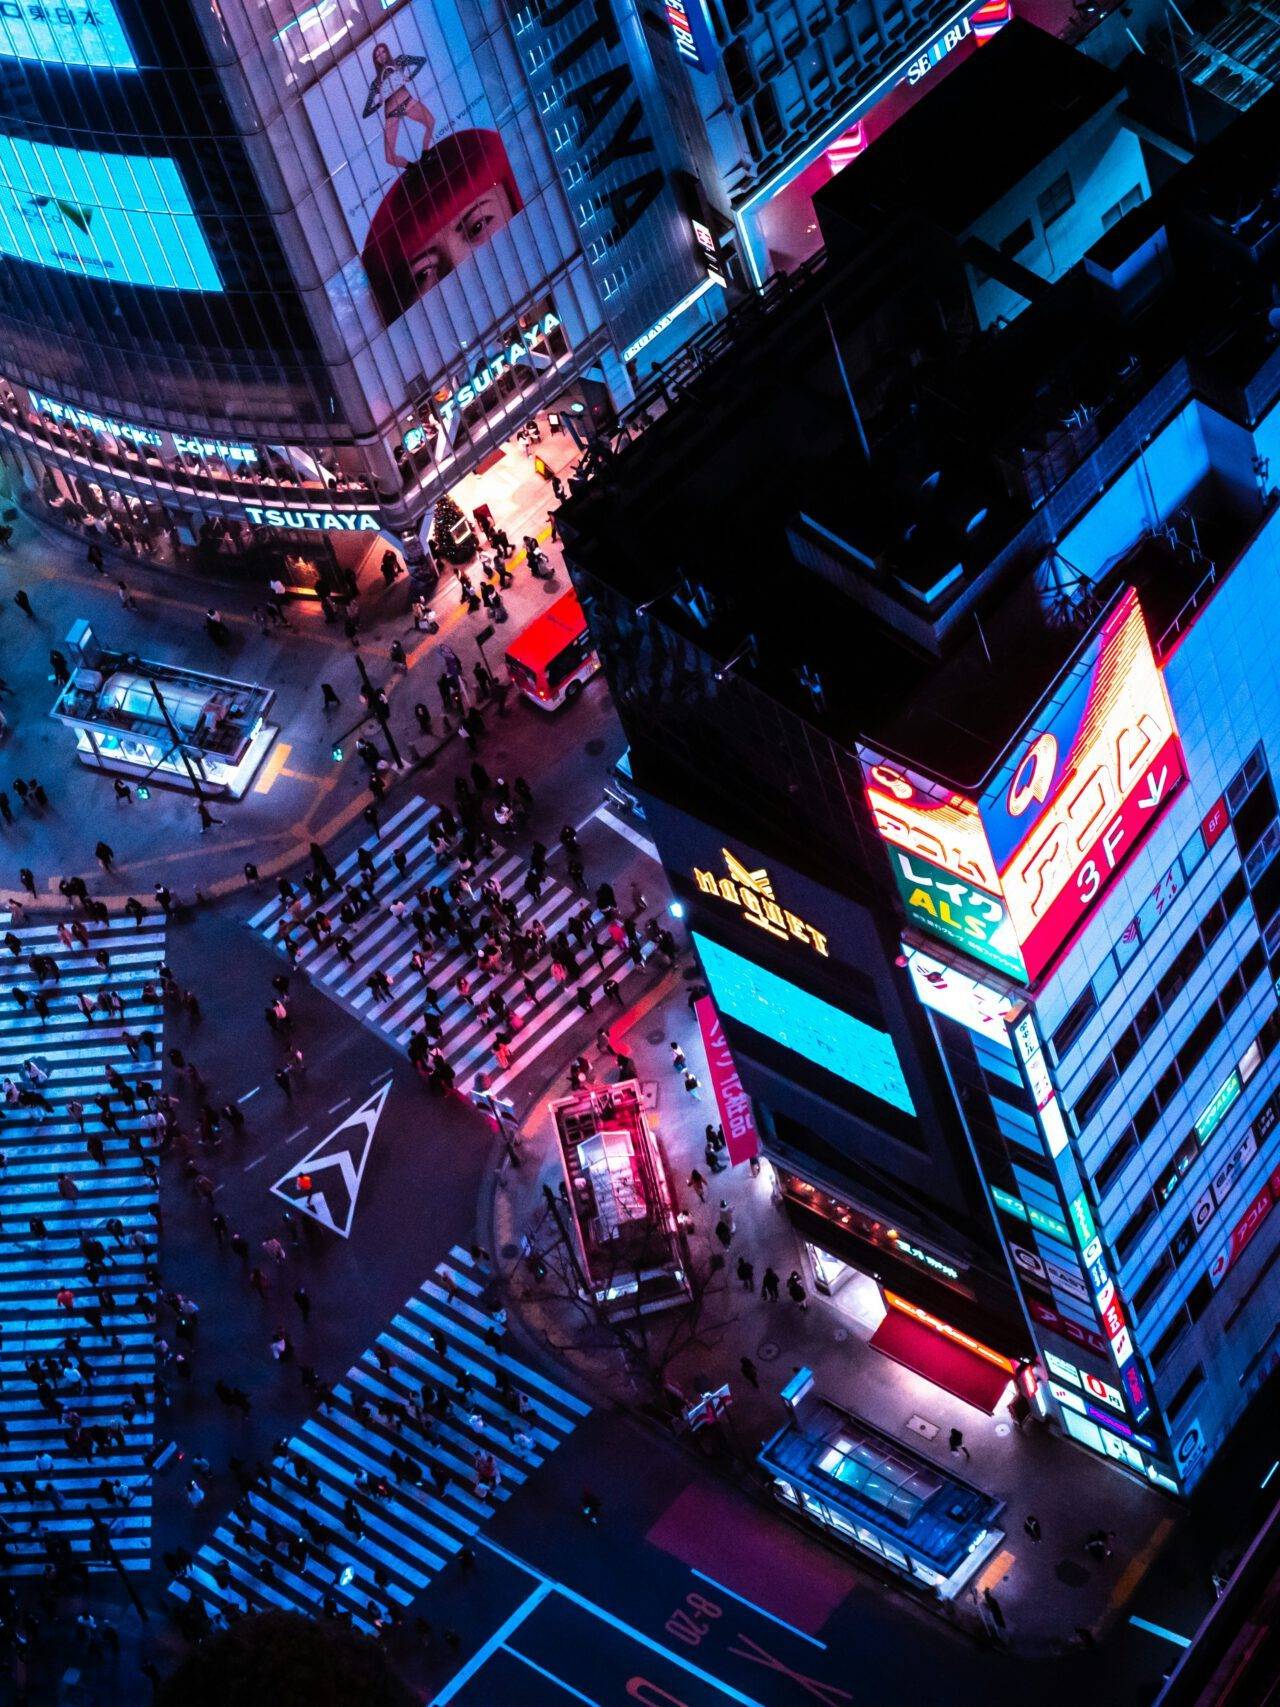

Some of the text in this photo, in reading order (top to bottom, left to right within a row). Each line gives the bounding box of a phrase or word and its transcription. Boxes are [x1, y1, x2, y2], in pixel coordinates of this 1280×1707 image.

[907, 16, 972, 85] SEIBU
[435, 93, 486, 140] LOUIS VUITTON
[439, 312, 561, 421] TSUTAYA
[40, 397, 258, 462] STARBUCKS COFFEE
[245, 506, 382, 532] TSUTAYA
[897, 851, 1004, 924] レイク
[1076, 814, 1126, 905] 3F
[1037, 1303, 1106, 1351] アコム
[664, 1591, 724, 1646] 8-20
